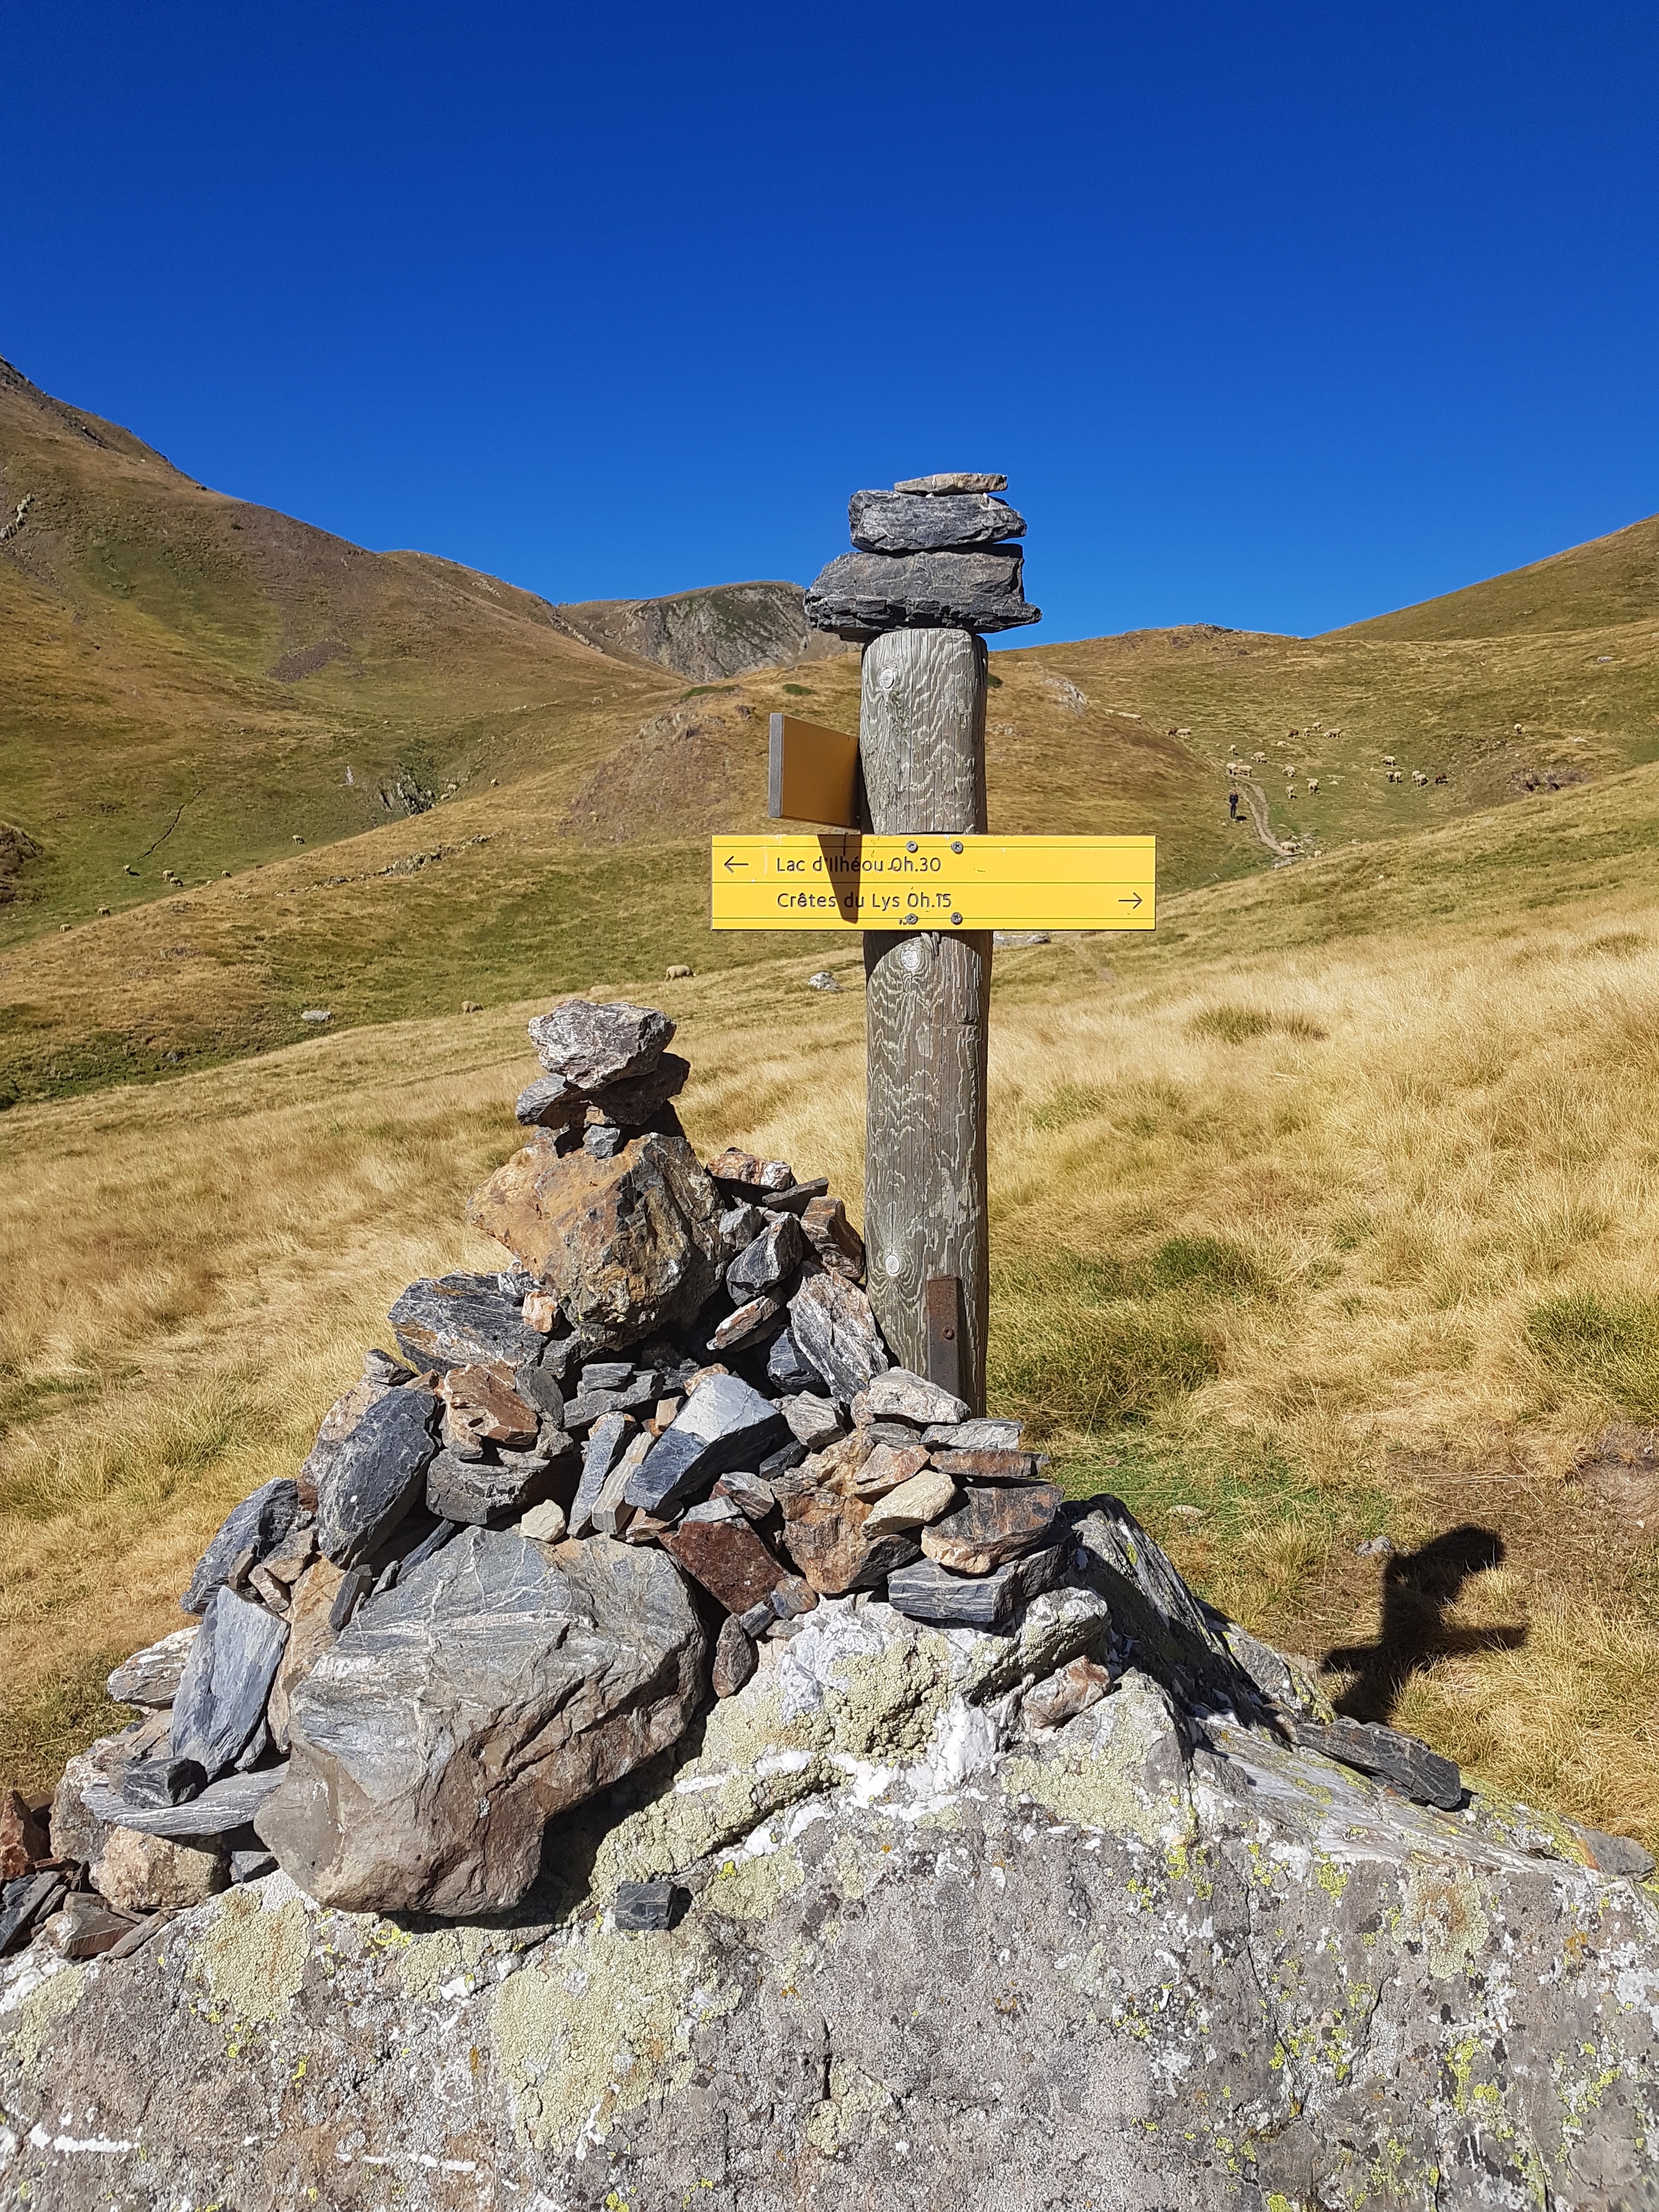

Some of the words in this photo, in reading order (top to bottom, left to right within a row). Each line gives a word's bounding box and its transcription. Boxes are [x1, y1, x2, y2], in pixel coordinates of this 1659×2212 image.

[777, 857, 805, 872] Lac
[812, 855, 884, 872] d'Ilhéou
[891, 856, 941, 872] 0h.30
[777, 892, 837, 908] Crêtes
[843, 891, 864, 908] du
[872, 893, 900, 911] Lys
[907, 891, 952, 908] 0h.15
